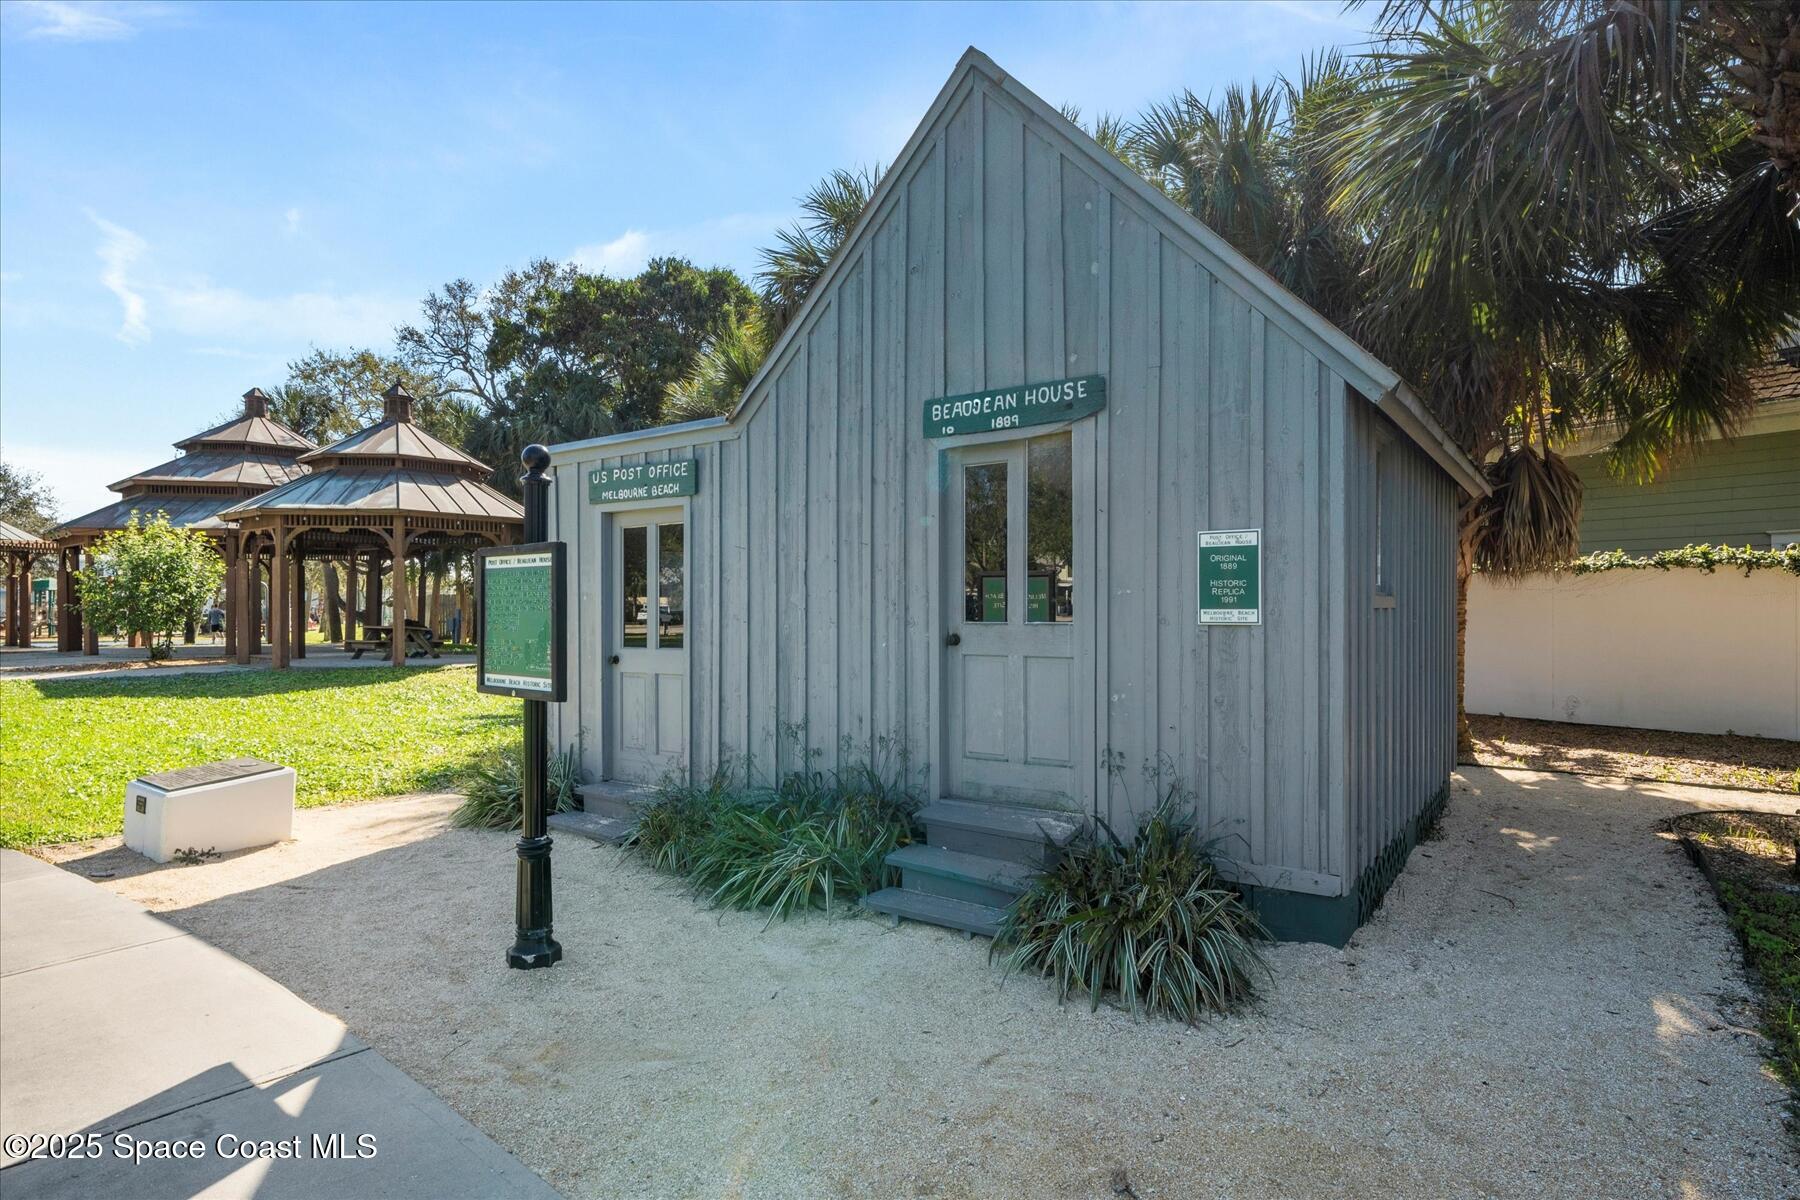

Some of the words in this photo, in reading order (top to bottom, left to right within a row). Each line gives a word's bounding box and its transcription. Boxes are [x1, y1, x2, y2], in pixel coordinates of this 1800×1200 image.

[1025, 380, 1088, 406] HOUSE
[991, 415, 1019, 429] 1889
[592, 471, 608, 484] US
[613, 466, 643, 481] POST
[648, 462, 688, 478] OFFICE
[601, 486, 648, 500] MELBOURNE
[651, 483, 680, 496] BEACH
[1209, 554, 1247, 562] ORIGINAL
[1220, 562, 1238, 570] 1889
[1209, 579, 1247, 587] HISTORIC
[1211, 587, 1246, 596] REPLICA
[1221, 596, 1237, 604] 1991
